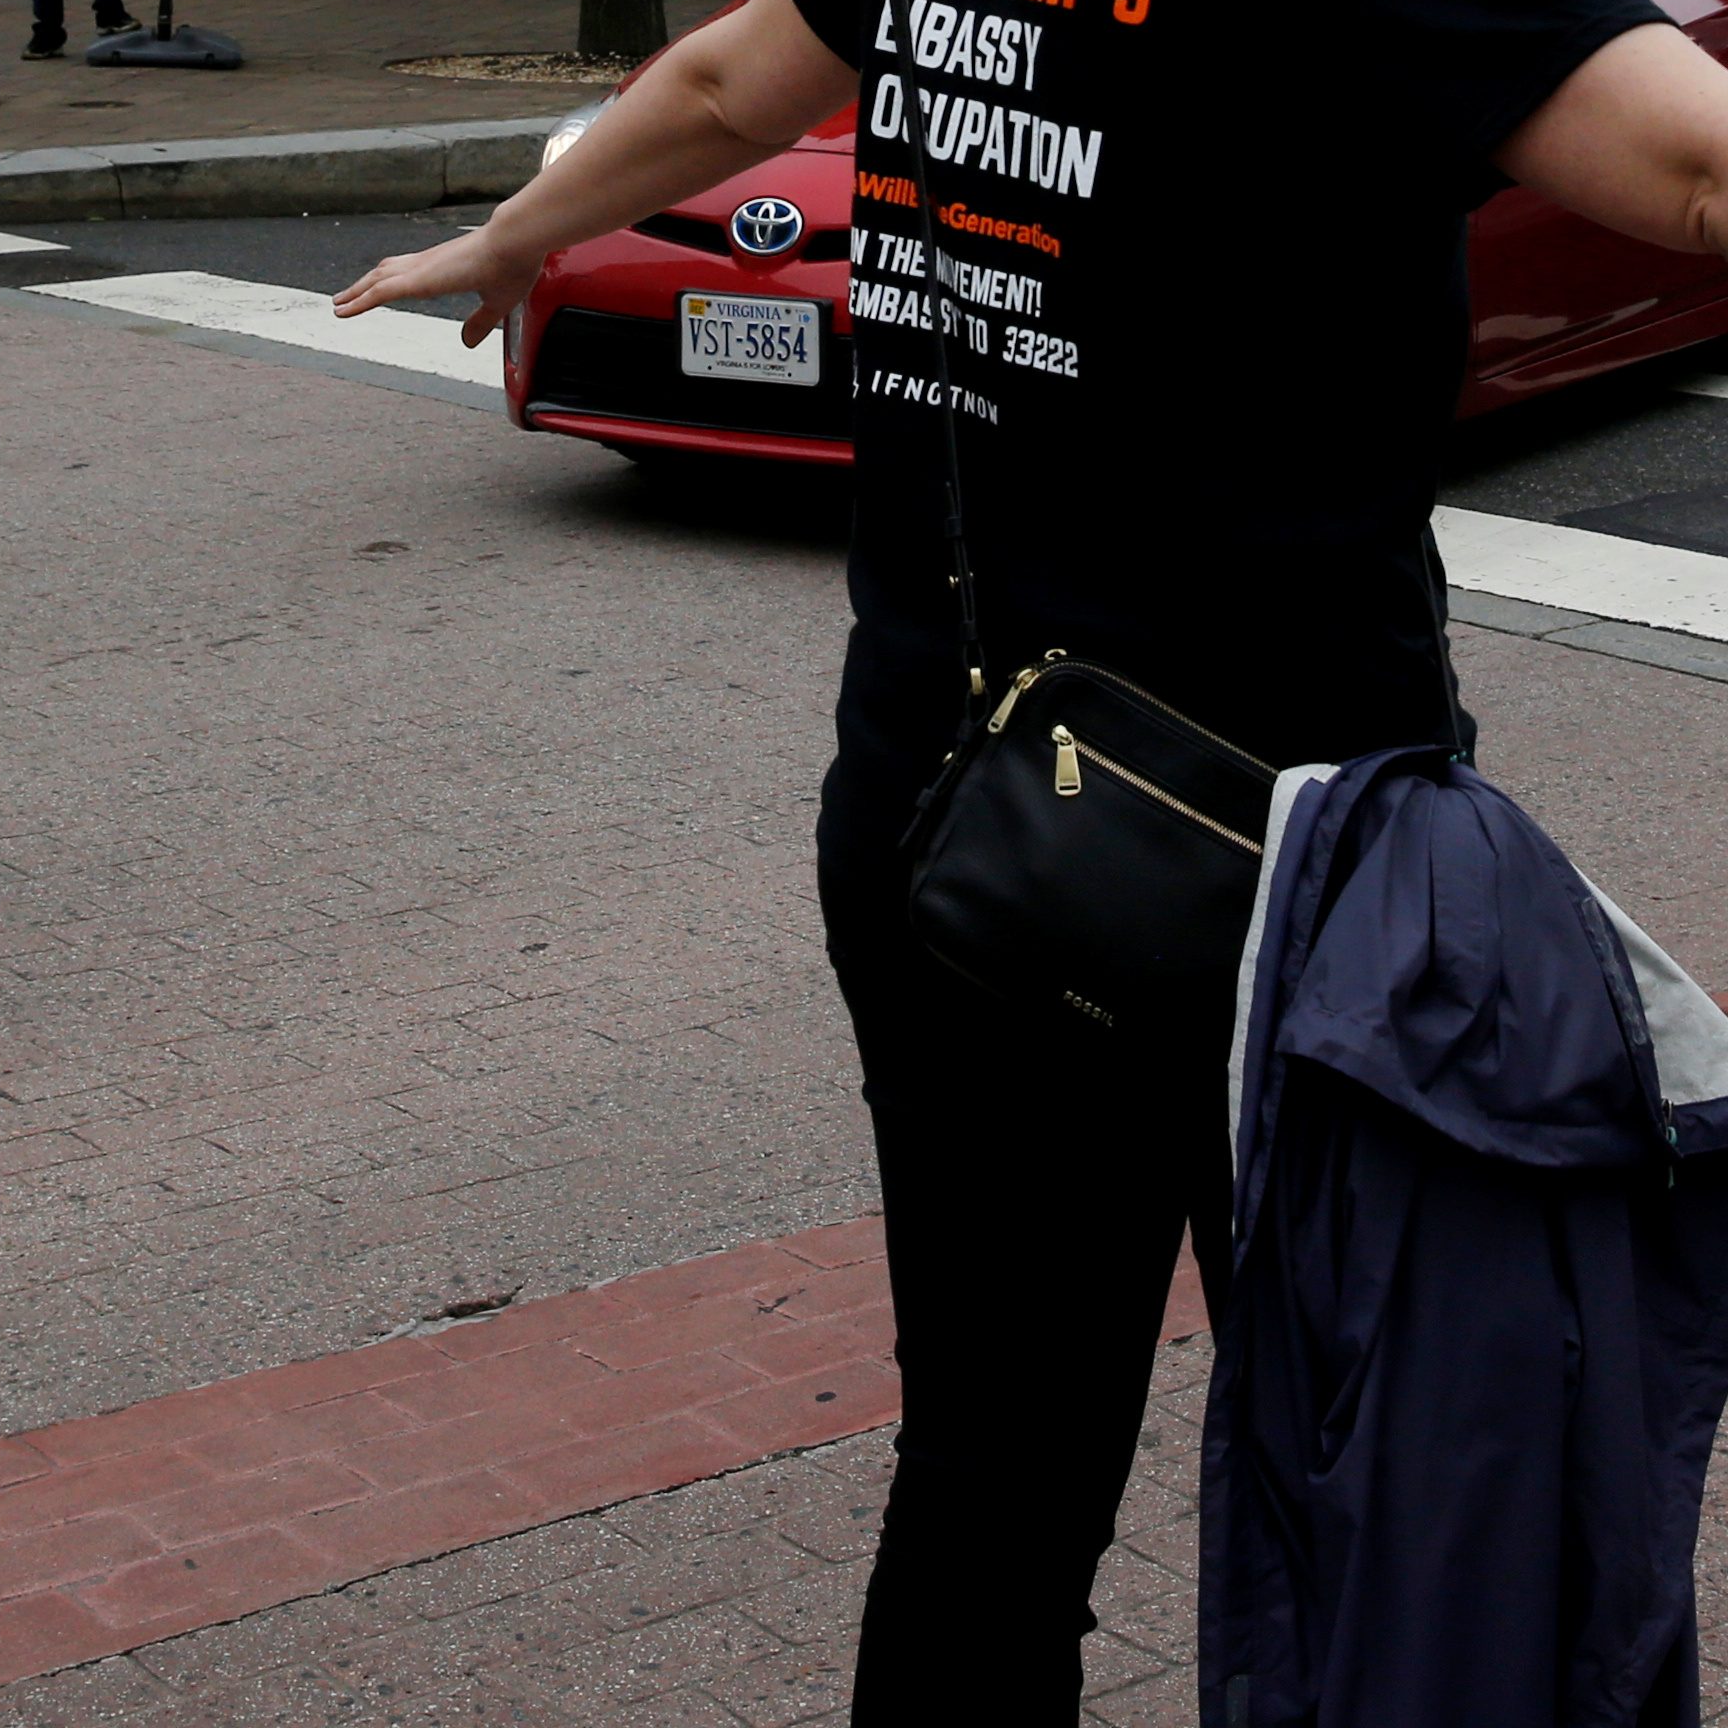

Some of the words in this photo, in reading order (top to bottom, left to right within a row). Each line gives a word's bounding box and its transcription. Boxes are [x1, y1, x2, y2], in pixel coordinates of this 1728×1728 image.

[870, 73, 1103, 199] OUPATION
[877, 232, 926, 278] THE
[717, 303, 782, 320] VIRGINIA
[689, 317, 807, 364] VST-5854
[965, 313, 989, 355] TO
[1002, 325, 1080, 379] 33222
[1063, 990, 1113, 1028] FOSSIL
